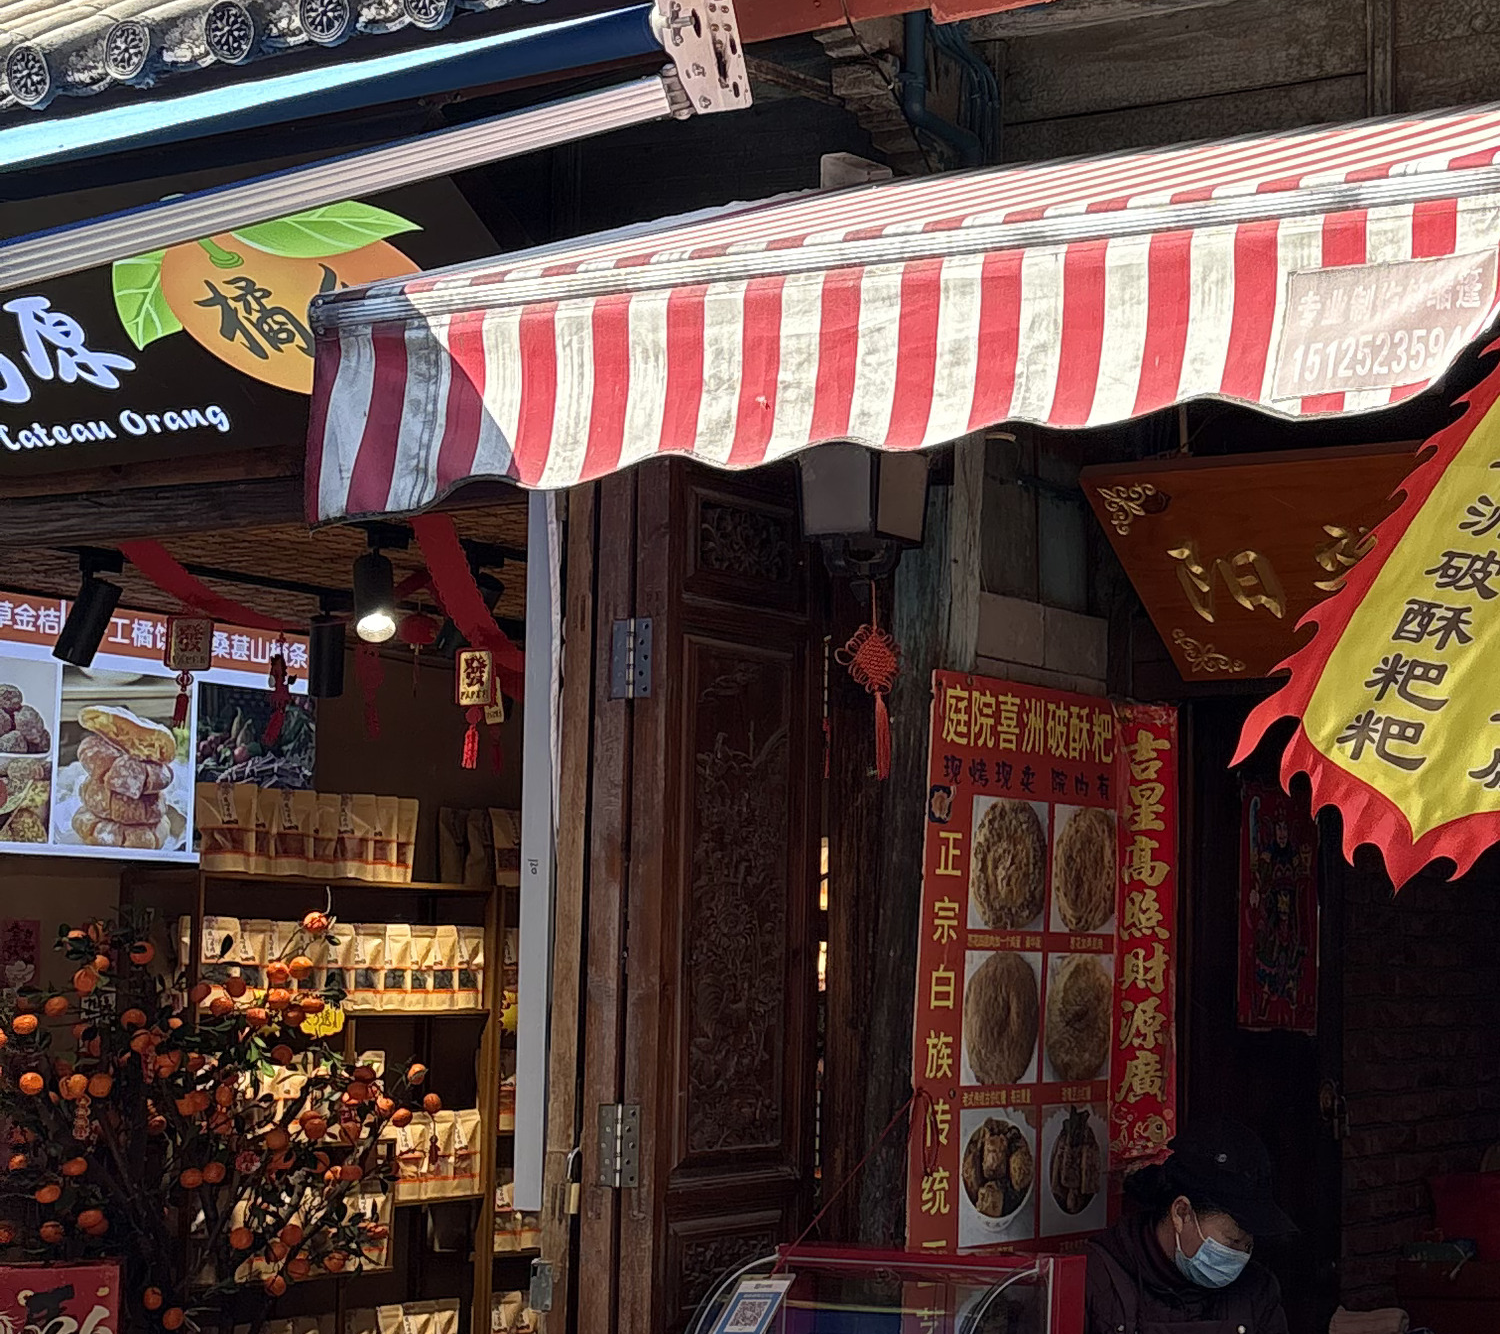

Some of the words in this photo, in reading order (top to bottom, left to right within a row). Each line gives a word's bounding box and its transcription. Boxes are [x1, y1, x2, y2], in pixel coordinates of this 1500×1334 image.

[194, 264, 340, 359] 橘
[1293, 325, 1466, 383] 1512523594
[119, 405, 230, 434] Orang
